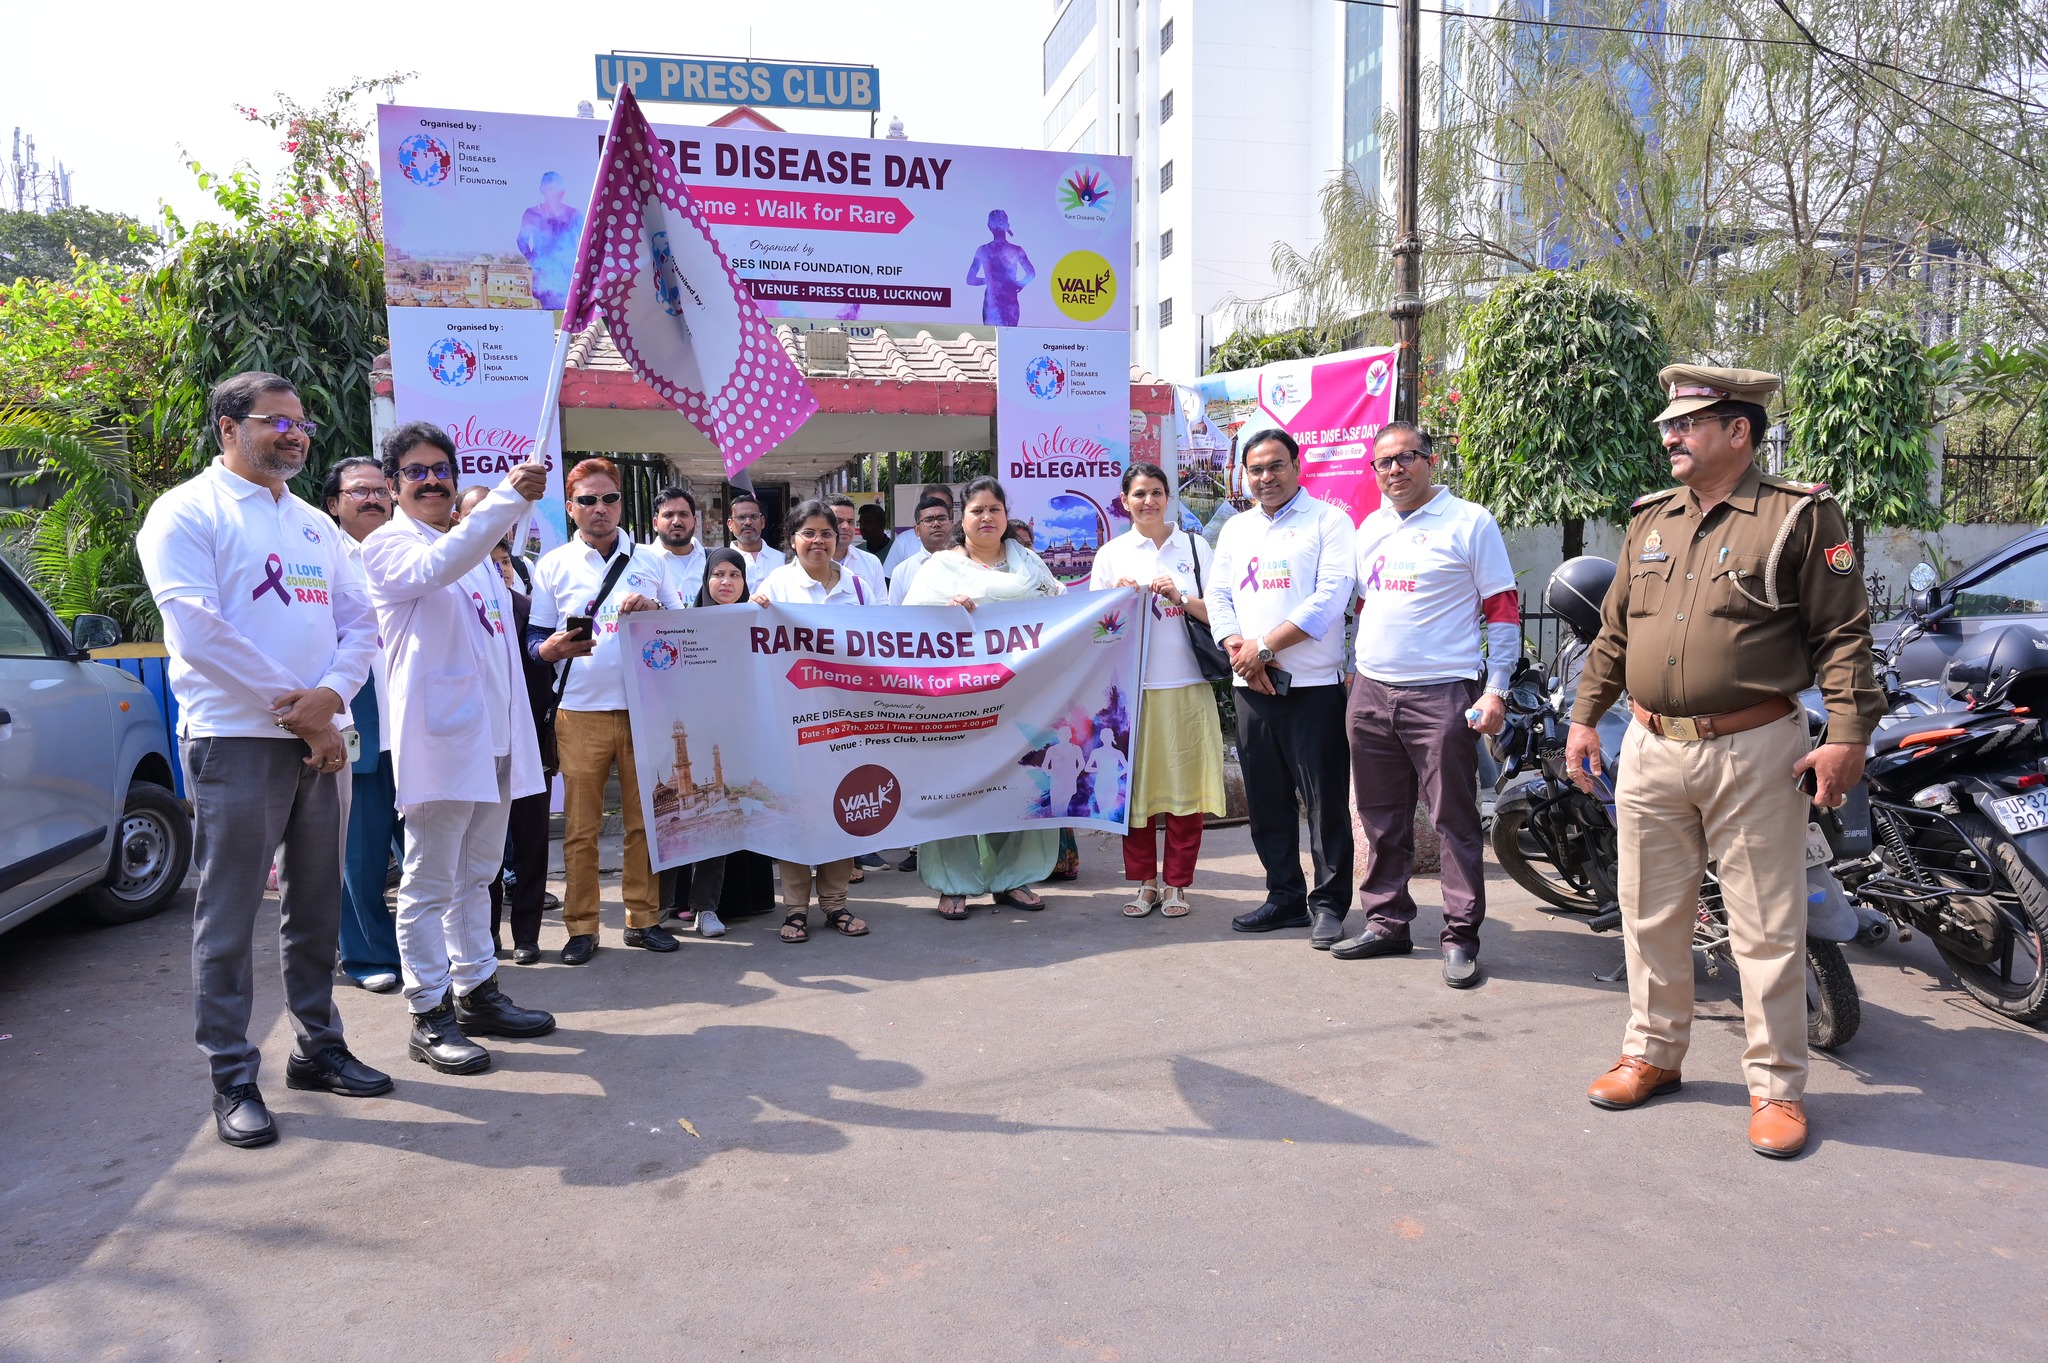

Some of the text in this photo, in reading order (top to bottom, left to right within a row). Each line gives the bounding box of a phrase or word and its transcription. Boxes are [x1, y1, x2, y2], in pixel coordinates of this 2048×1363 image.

[601, 59, 871, 105] UP PRESS CLUB
[420, 119, 463, 129] Organised
[466, 122, 477, 131] by
[716, 143, 871, 186] DISEASE
[885, 155, 952, 191] DAY
[695, 200, 736, 215] eme
[756, 199, 807, 220] Walk
[814, 203, 843, 221] for
[850, 204, 896, 224] Rare
[749, 239, 815, 256] Organised by
[759, 260, 791, 271] INDIA
[794, 262, 873, 276] FOUNDATION,
[877, 265, 903, 276] RDIF
[758, 283, 799, 295] VENUE
[808, 286, 844, 298] PRESS
[847, 288, 880, 300] CLUB,
[883, 289, 943, 302] LUCKNOW
[1062, 293, 1096, 304] RARE
[447, 324, 487, 332] Organised
[489, 324, 499, 332] by
[1043, 343, 1075, 351] Organised
[447, 415, 536, 455] elcome
[1293, 423, 1380, 445] RARE DISEASE DAY
[1022, 425, 1111, 466] Welcome
[1010, 461, 1122, 478] DELEGATES
[287, 563, 323, 578] I LOVE
[1268, 559, 1288, 570] LOVE
[1393, 561, 1416, 571] LOVE
[286, 576, 328, 590] SOMEONE
[1262, 577, 1291, 590] RARE
[1384, 579, 1416, 592] RARE
[294, 588, 329, 605] RARE
[1164, 606, 1185, 617] RAR
[750, 623, 1044, 659] RARE DISEASE DAY
[800, 666, 863, 686] Theme
[880, 674, 923, 690] Walk
[928, 674, 953, 690] for
[959, 672, 1001, 688] Rare
[792, 704, 1005, 725] RARE DISEASES INDIA FOUNDATION, RDIF
[801, 731, 820, 739] Date
[826, 726, 840, 735] Feb
[841, 724, 862, 732] 27th,
[892, 723, 914, 731] Time
[981, 718, 994, 727] pm
[829, 741, 857, 752] Venue
[865, 737, 891, 745] Press
[893, 735, 919, 743] Club,
[922, 734, 966, 742] Lucknow
[945, 789, 985, 800] LUCKNOW
[986, 784, 1008, 793] WALK
[845, 807, 880, 823] RARE
